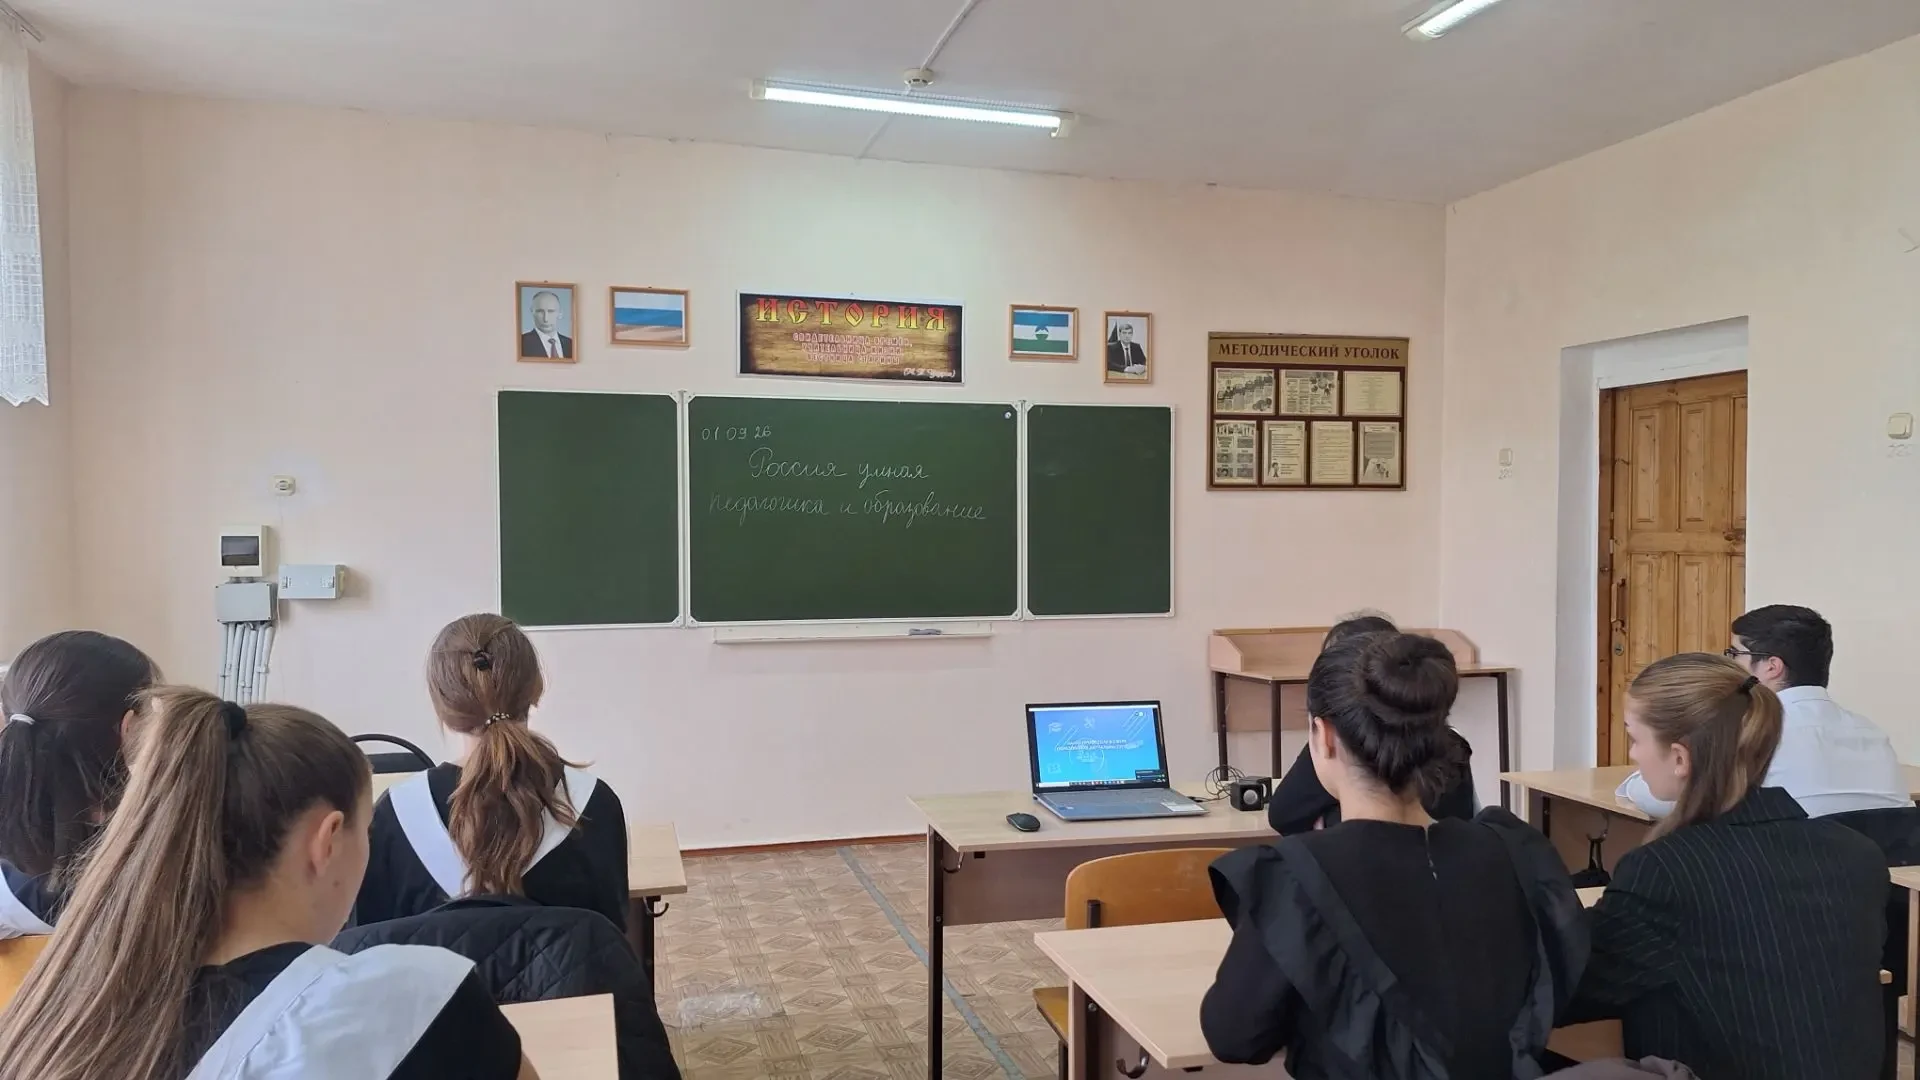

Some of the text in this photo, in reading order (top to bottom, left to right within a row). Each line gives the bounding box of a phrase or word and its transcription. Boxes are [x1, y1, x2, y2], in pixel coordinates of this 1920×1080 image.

[755, 297, 947, 331] ИСТОРИЯ
[1218, 343, 1400, 360] МЕТОДИЧЕСКИЙ УГОЛОК
[749, 447, 929, 488] Россия умная
[840, 501, 858, 515] и
[864, 489, 986, 528] образование
